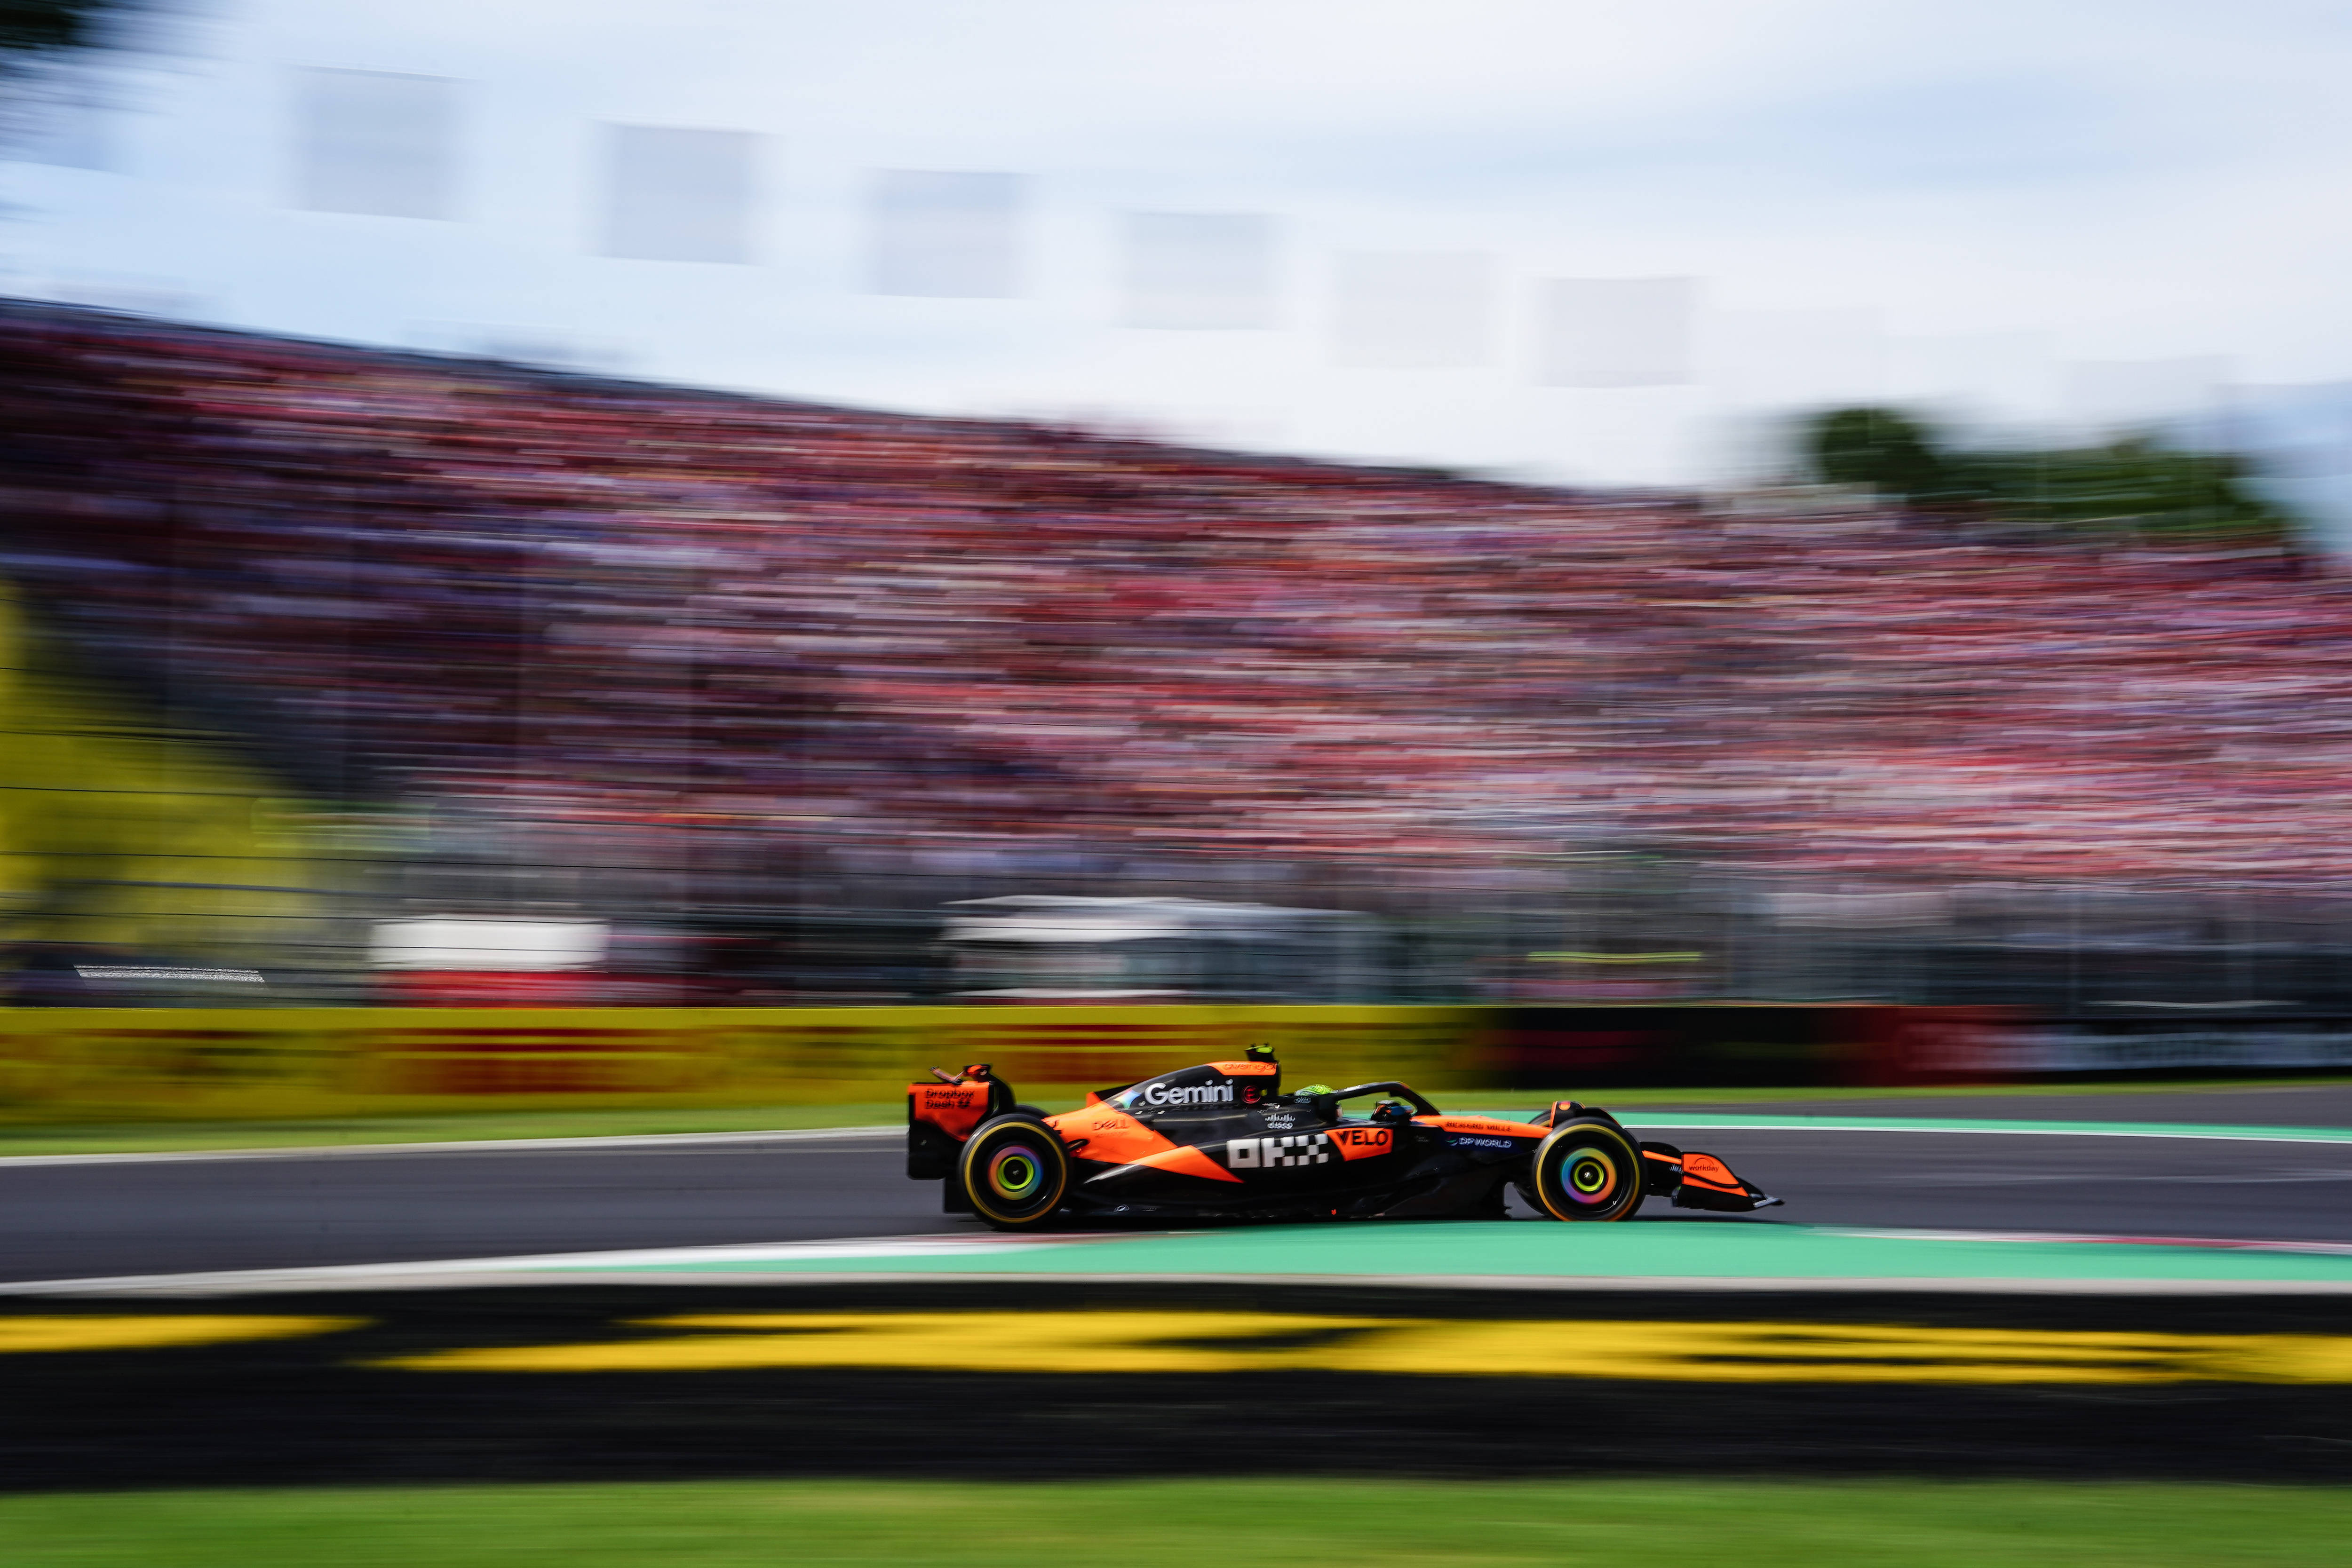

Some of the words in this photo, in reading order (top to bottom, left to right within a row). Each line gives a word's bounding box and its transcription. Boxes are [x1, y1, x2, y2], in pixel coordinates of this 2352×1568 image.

[925, 1088, 975, 1099] Dropbox
[1144, 1078, 1233, 1105] Gemini
[925, 1100, 954, 1109] Dash
[1092, 1119, 1130, 1131] DELL
[1336, 1130, 1388, 1146] VELO
[1459, 1137, 1474, 1145] DP
[1475, 1138, 1512, 1148] WORLD
[1227, 1133, 1328, 1168] OKX
[1689, 1164, 1719, 1172] workday
